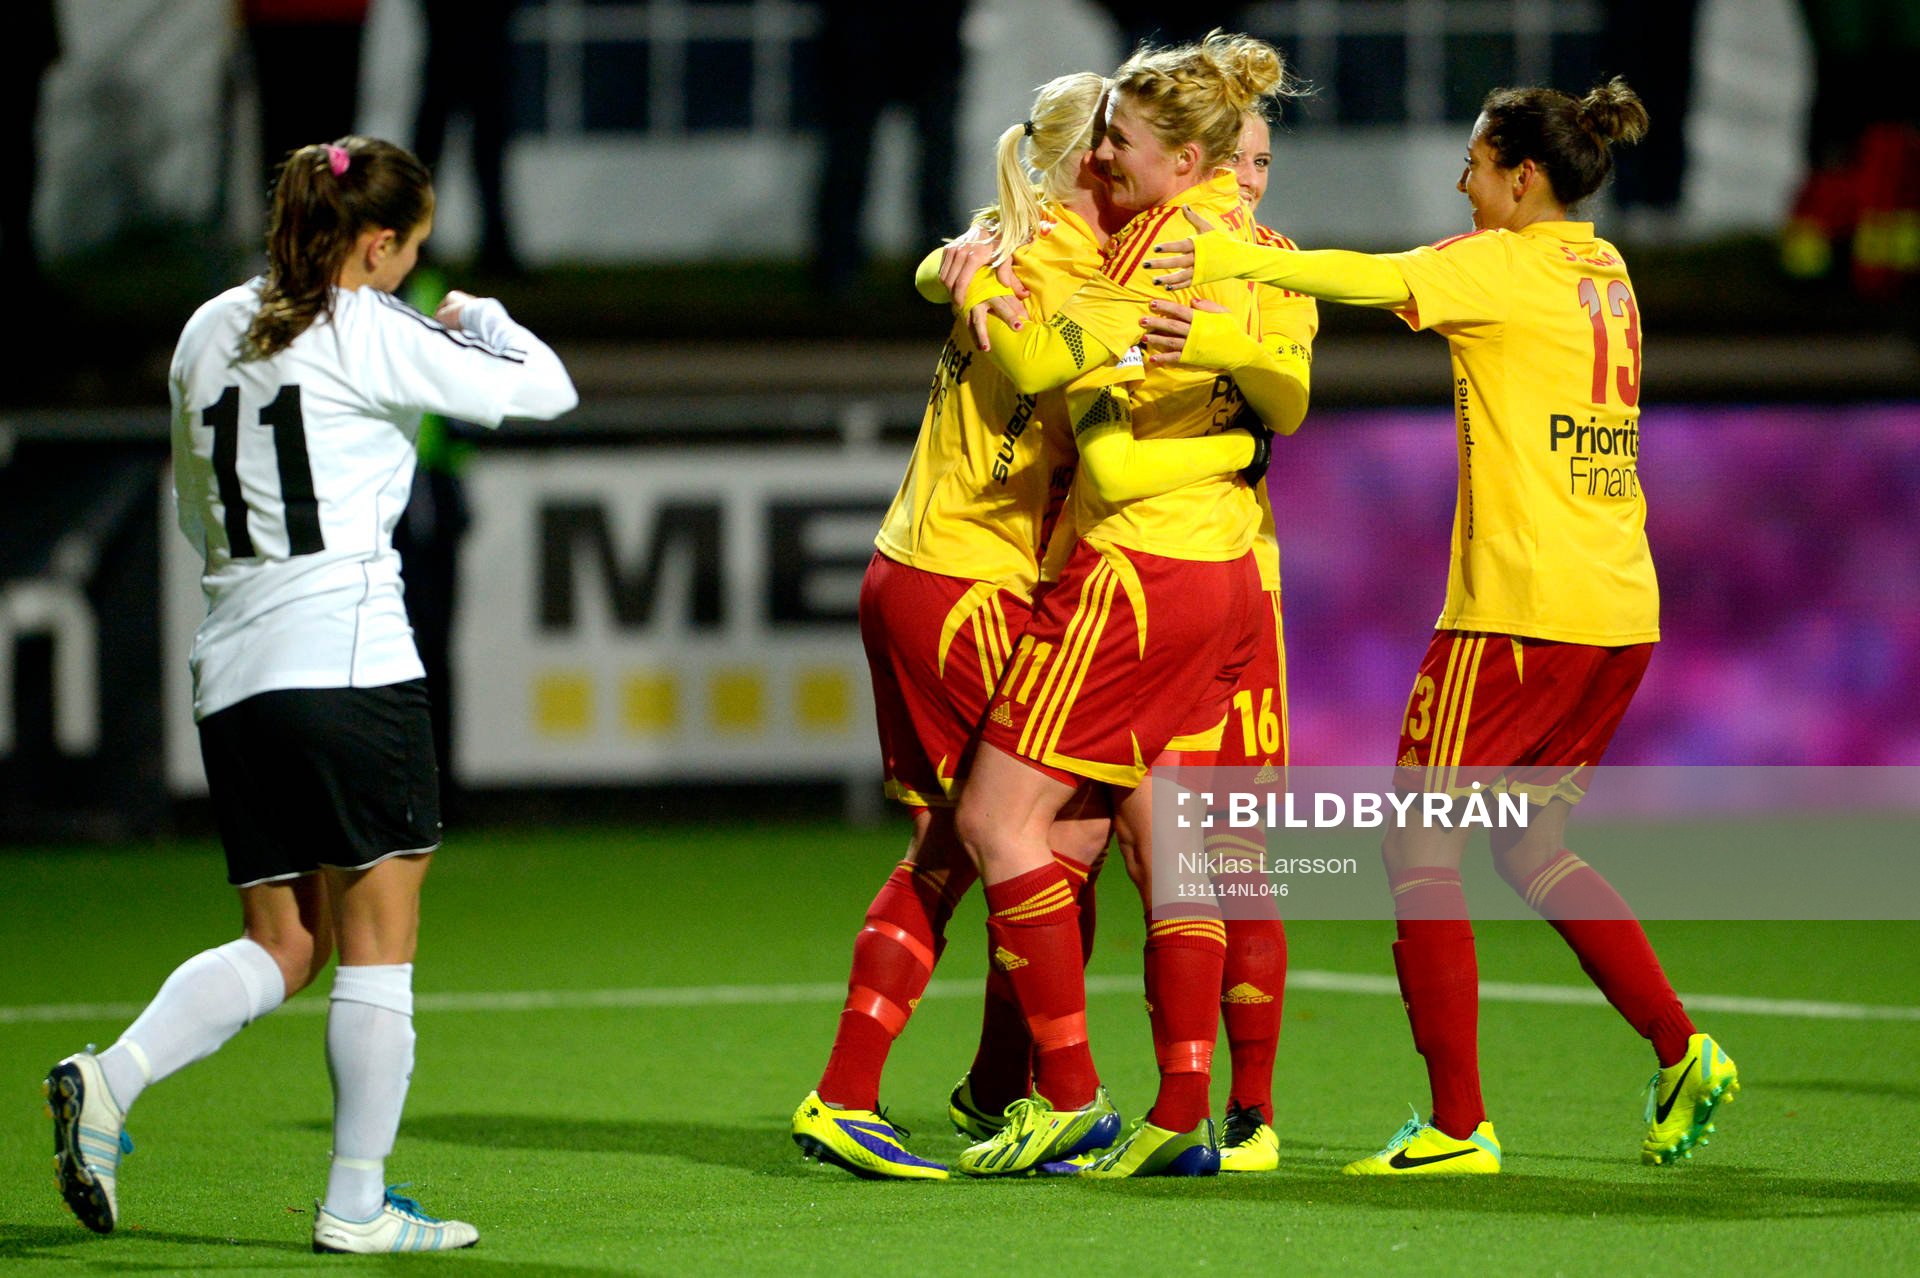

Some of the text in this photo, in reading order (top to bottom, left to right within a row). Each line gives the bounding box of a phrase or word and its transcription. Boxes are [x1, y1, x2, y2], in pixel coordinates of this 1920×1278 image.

[1577, 277, 1640, 407] 13
[202, 384, 326, 558] 11
[1550, 414, 1639, 458] Priorit
[1001, 634, 1053, 705] 11
[1233, 688, 1279, 757] 16
